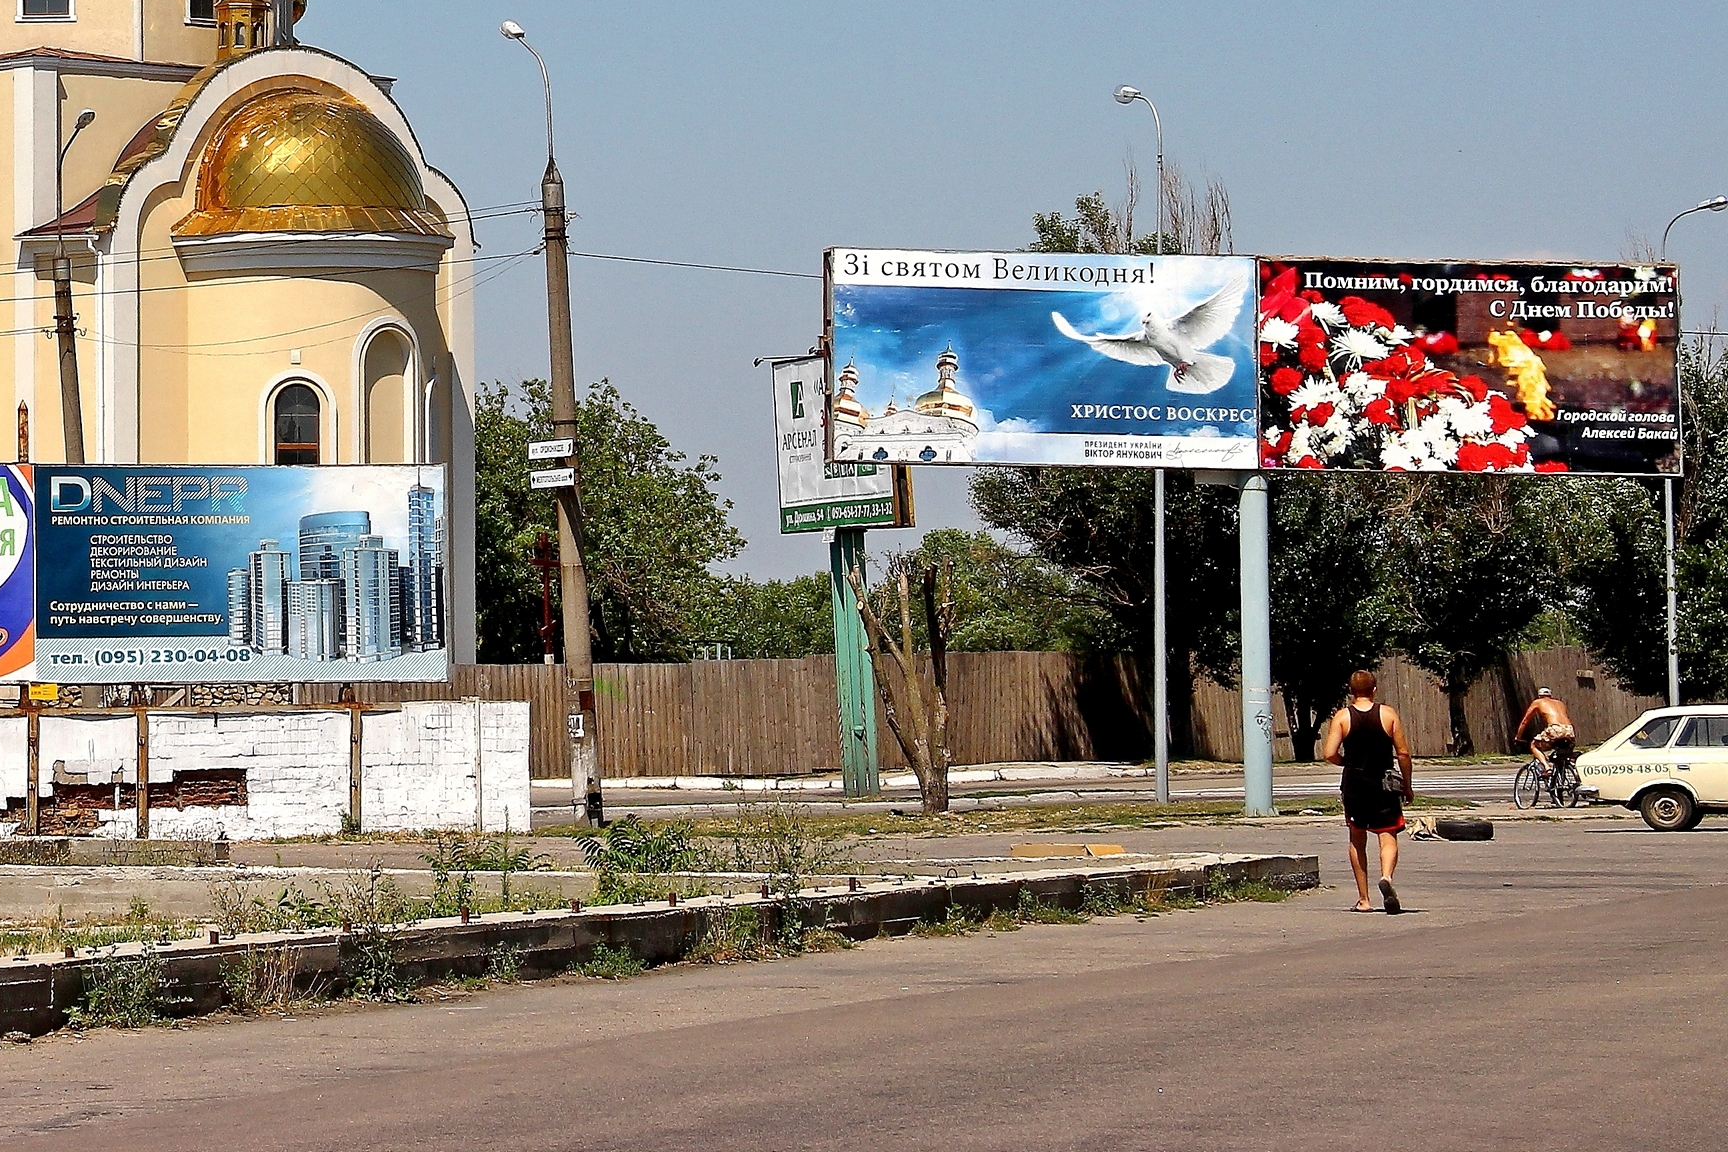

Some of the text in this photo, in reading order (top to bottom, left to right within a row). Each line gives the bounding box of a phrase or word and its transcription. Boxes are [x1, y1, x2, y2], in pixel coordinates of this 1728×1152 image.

[844, 253, 1155, 288] Зі святом Великодня!
[1303, 272, 1674, 297] Помним, гордимся, благодарим!
[1489, 300, 1675, 321] С Днем Победы!
[1071, 404, 1257, 423] ХРИСТОС ВОСКРЕС!
[1557, 409, 1676, 424] Городской голова
[1581, 426, 1679, 440] Алексей Бакай
[782, 429, 817, 451] АРСЕНАЛ
[1084, 440, 1162, 449] ПРЕЗИДЕНТ УКРАЇНИ
[1084, 449, 1114, 459] ВІКТОР
[1116, 450, 1162, 460] ЯНУКОВИЧ
[50, 475, 249, 513] DNEPR
[51, 515, 250, 525] РЕМОНТНО СТРОИТЕЛЬНАЯ КОМПАНИЯ
[89, 534, 173, 545] СТРОИТЕЛЬСТВО
[89, 546, 178, 557] ДЕКОРИРОВАНИЕ
[90, 555, 208, 568] ТЕКСТИЛЬНЫЙ ДИЗАЙН
[90, 569, 139, 579] РЕМОНТЫ
[90, 579, 190, 592] ДИЗАЙН ИНТЕРЬЕРА
[49, 600, 145, 613] Сотрудничество
[146, 602, 153, 610] с
[154, 602, 186, 610] нами
[49, 613, 224, 626] путь навстречу совершенству.
[50, 648, 251, 666] тел. (095) 230-04-08
[1583, 764, 1669, 777] (050)298-48-05
